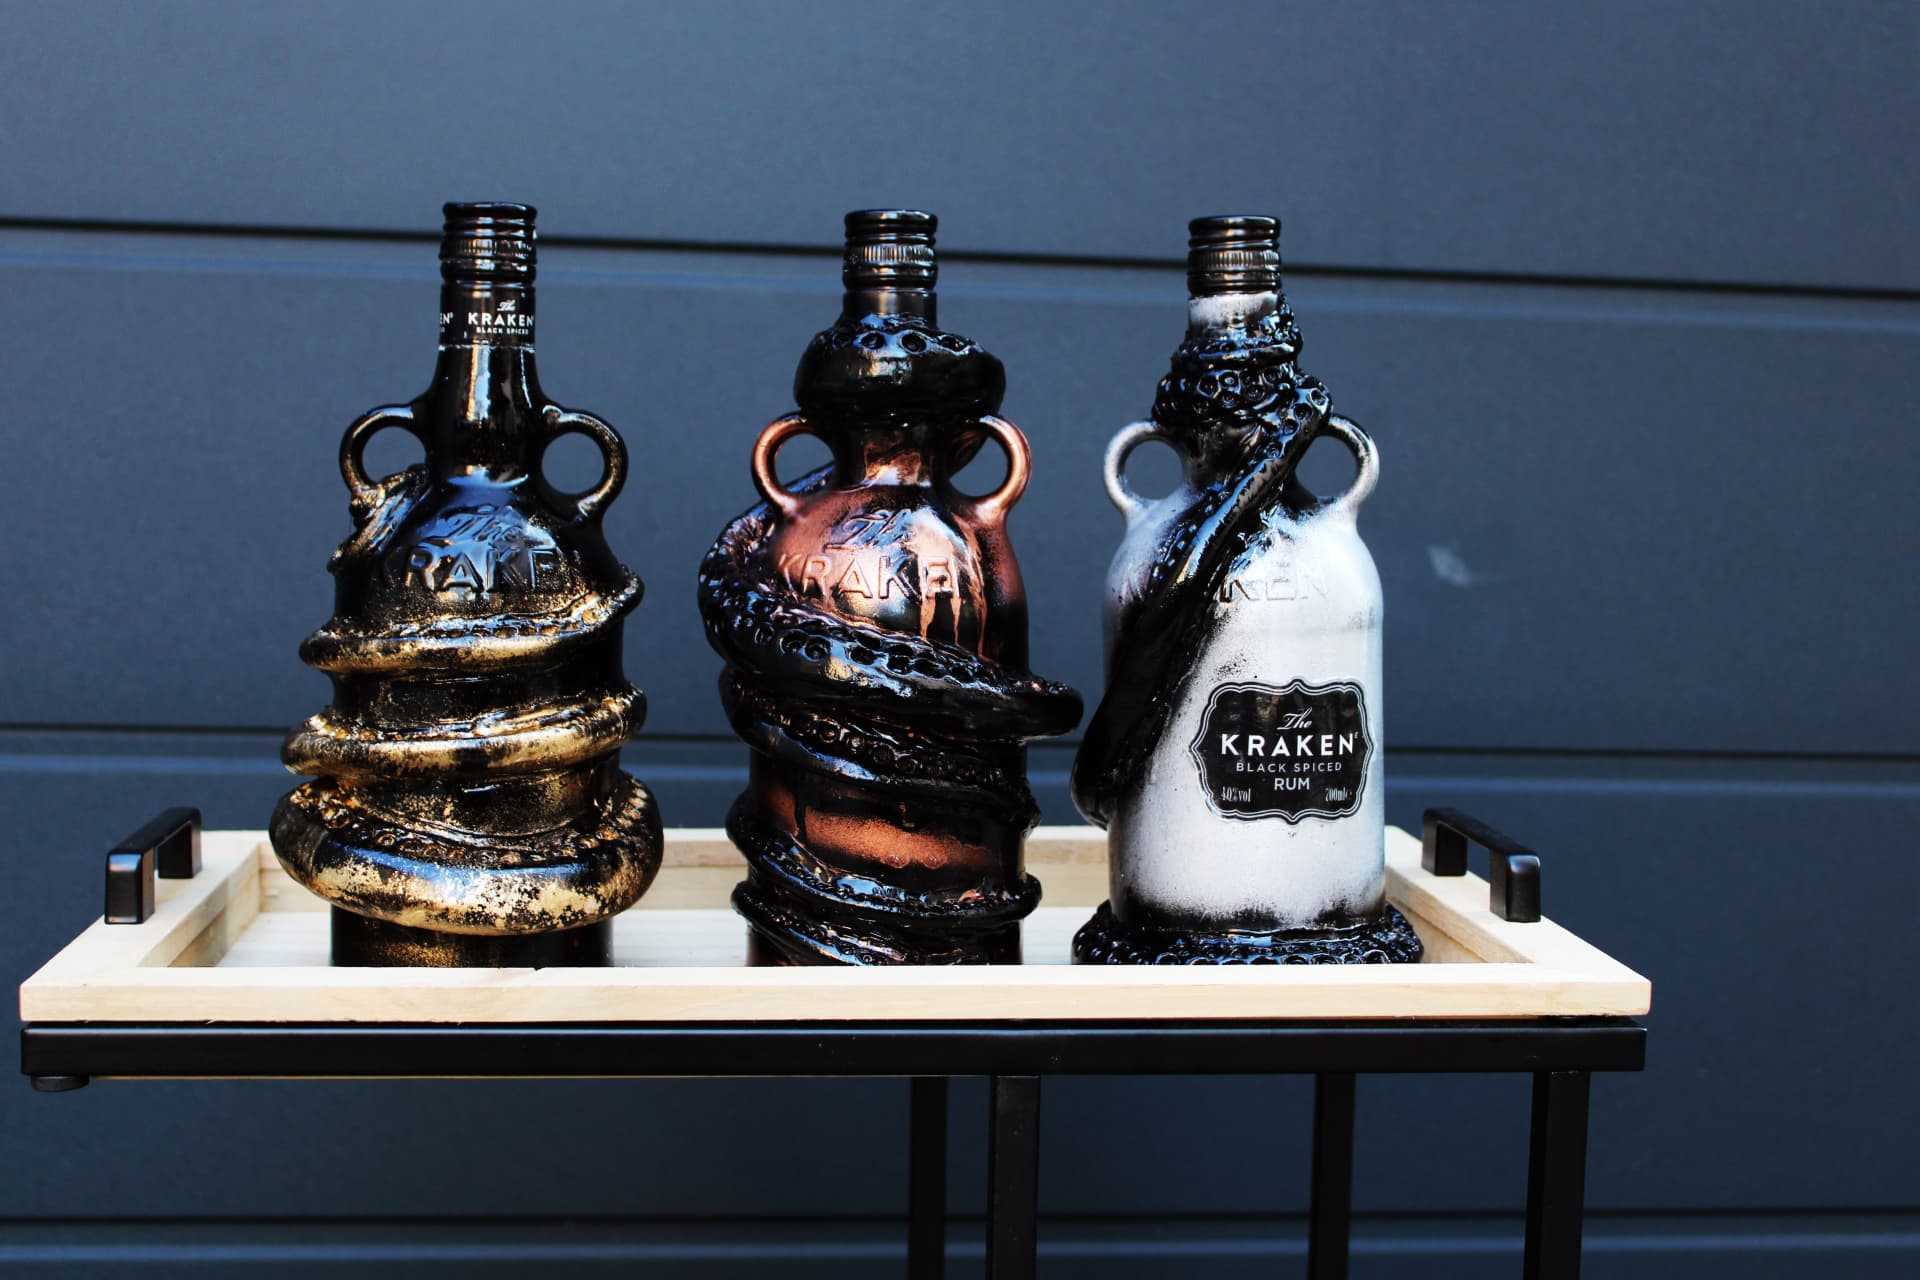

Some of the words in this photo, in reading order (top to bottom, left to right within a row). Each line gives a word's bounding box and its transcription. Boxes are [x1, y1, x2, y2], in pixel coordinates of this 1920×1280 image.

[467, 312, 534, 327] KRAKEN
[476, 327, 503, 335] BLACK
[403, 545, 560, 593] RAKE
[778, 553, 960, 601] KRAKE
[1277, 707, 1313, 730] The
[1221, 733, 1354, 757] KRAKEN
[1236, 762, 1286, 773] BLACK
[1293, 762, 1342, 773] SPICED
[1274, 777, 1311, 791] RUM
